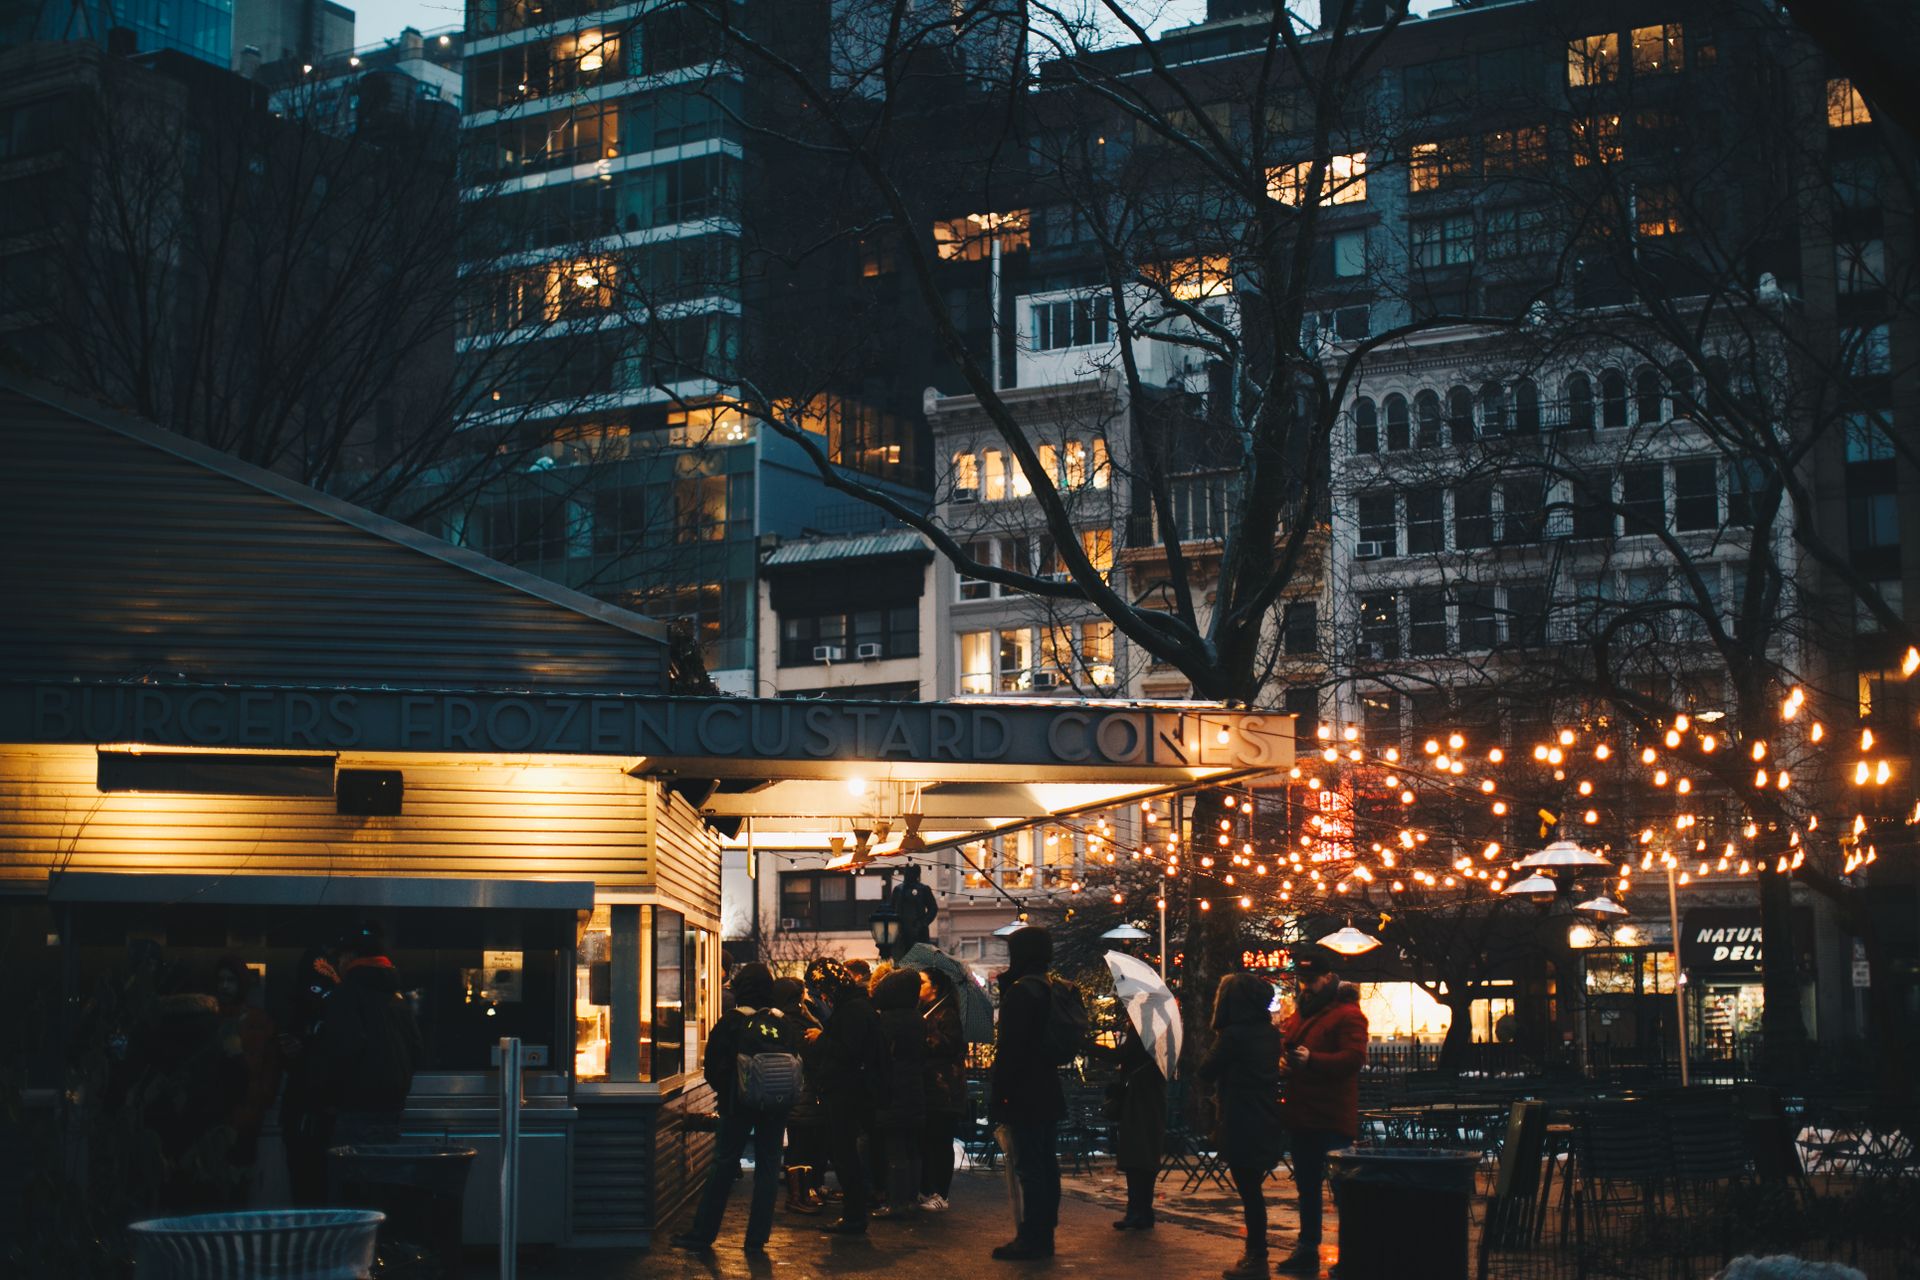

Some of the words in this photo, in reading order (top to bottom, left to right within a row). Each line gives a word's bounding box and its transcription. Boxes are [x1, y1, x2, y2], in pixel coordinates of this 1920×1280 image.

[36, 690, 361, 748] BURGERS
[403, 695, 676, 753] FROZEN
[697, 702, 1011, 762] CUSTARD
[1049, 712, 1272, 766] CONES
